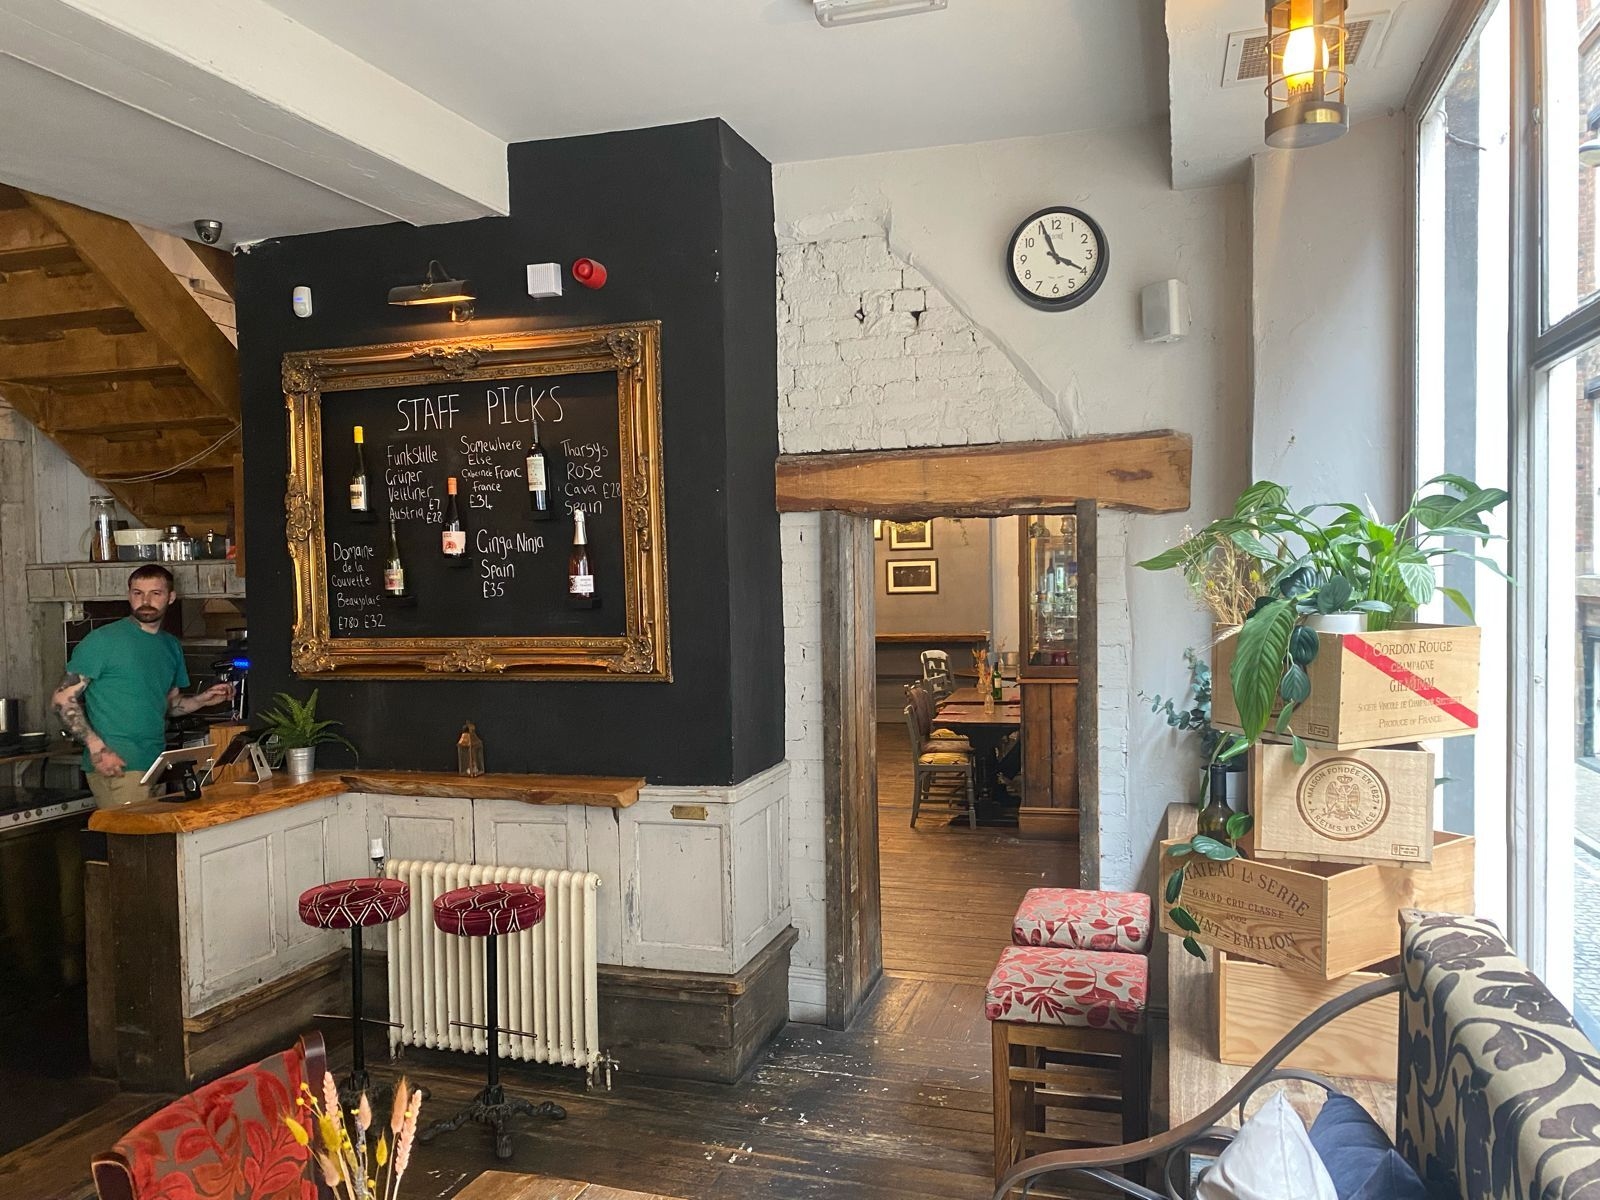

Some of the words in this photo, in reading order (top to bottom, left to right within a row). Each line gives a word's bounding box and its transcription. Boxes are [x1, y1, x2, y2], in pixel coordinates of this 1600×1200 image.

[1051, 219, 1062, 230] 12
[1025, 237, 1035, 248] 10
[1081, 233, 1088, 244] 2
[1020, 254, 1028, 264] 9
[1085, 249, 1093, 260] 3
[1024, 269, 1032, 279] 8
[1079, 266, 1088, 276] 4
[1035, 280, 1043, 292] 7
[1051, 284, 1060, 294] 6
[1067, 278, 1076, 288] 5
[397, 393, 460, 432] STAFF
[486, 384, 563, 425] PICKS
[460, 435, 522, 455] Somewhere
[560, 439, 609, 462] Tharsys
[468, 454, 493, 466] Else
[385, 468, 423, 486] Grüner
[494, 465, 522, 480] Franc
[388, 486, 434, 503] Veltliner
[564, 482, 597, 497] Cava
[602, 482, 621, 499] £28
[429, 498, 441, 511] £7
[469, 494, 494, 511] £34
[564, 500, 603, 515] Spain
[389, 506, 425, 520] Austria
[426, 511, 443, 524] £28
[516, 532, 545, 554] Ninja
[342, 560, 352, 573] de
[354, 561, 364, 572] la
[480, 558, 515, 580] Spain
[482, 580, 505, 599] £35
[364, 613, 386, 629] £32
[1418, 641, 1453, 654] ROUGE
[1307, 771, 1327, 798] MAISON
[1361, 774, 1374, 785] EN
[1369, 784, 1380, 805] 1827
[1344, 811, 1377, 833] FRANCE
[1182, 860, 1236, 881] HATEAU
[1257, 874, 1310, 917] SERRE
[1192, 888, 1222, 904] GRAND
[1226, 896, 1245, 909] CRU
[1247, 903, 1286, 919] CLASSE
